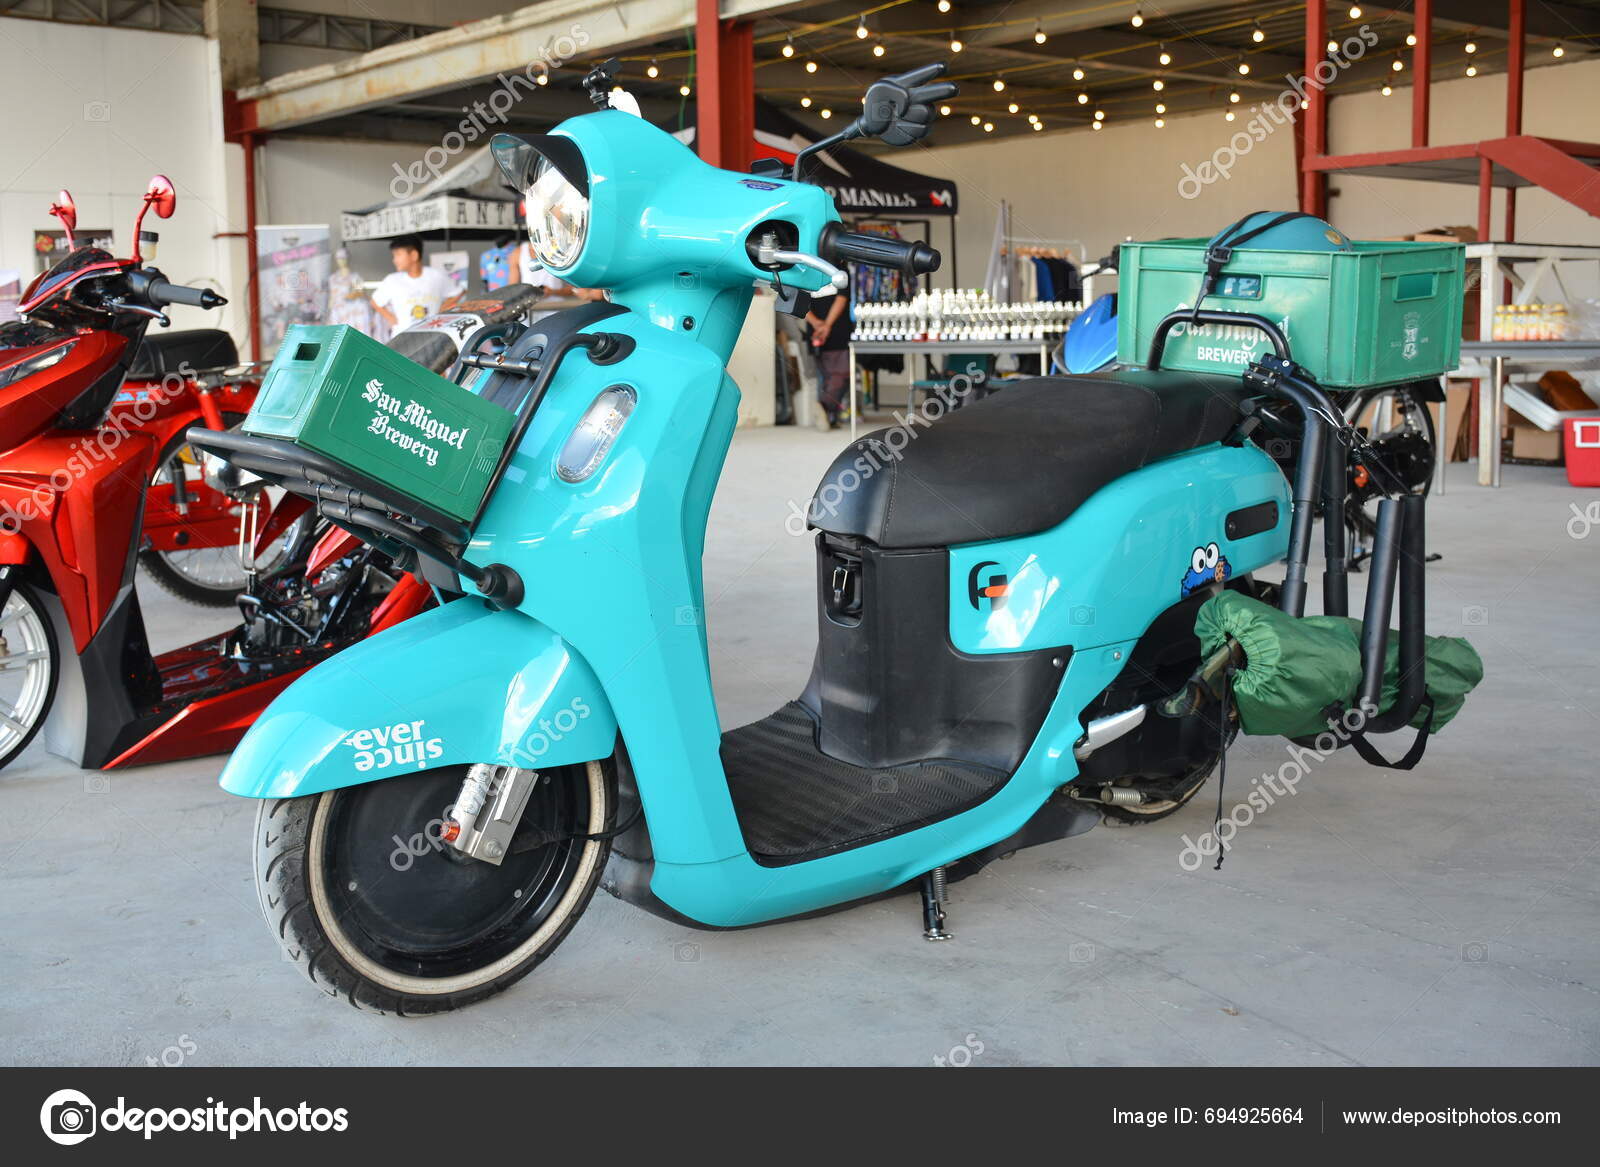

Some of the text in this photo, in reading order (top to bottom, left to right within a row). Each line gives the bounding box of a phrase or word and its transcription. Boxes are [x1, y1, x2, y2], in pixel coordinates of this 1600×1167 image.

[1197, 346, 1257, 365] BREWERY
[361, 378, 470, 450] San Miguel
[367, 410, 439, 467] Brewery
[352, 719, 425, 750] ever
[353, 737, 443, 772] since
